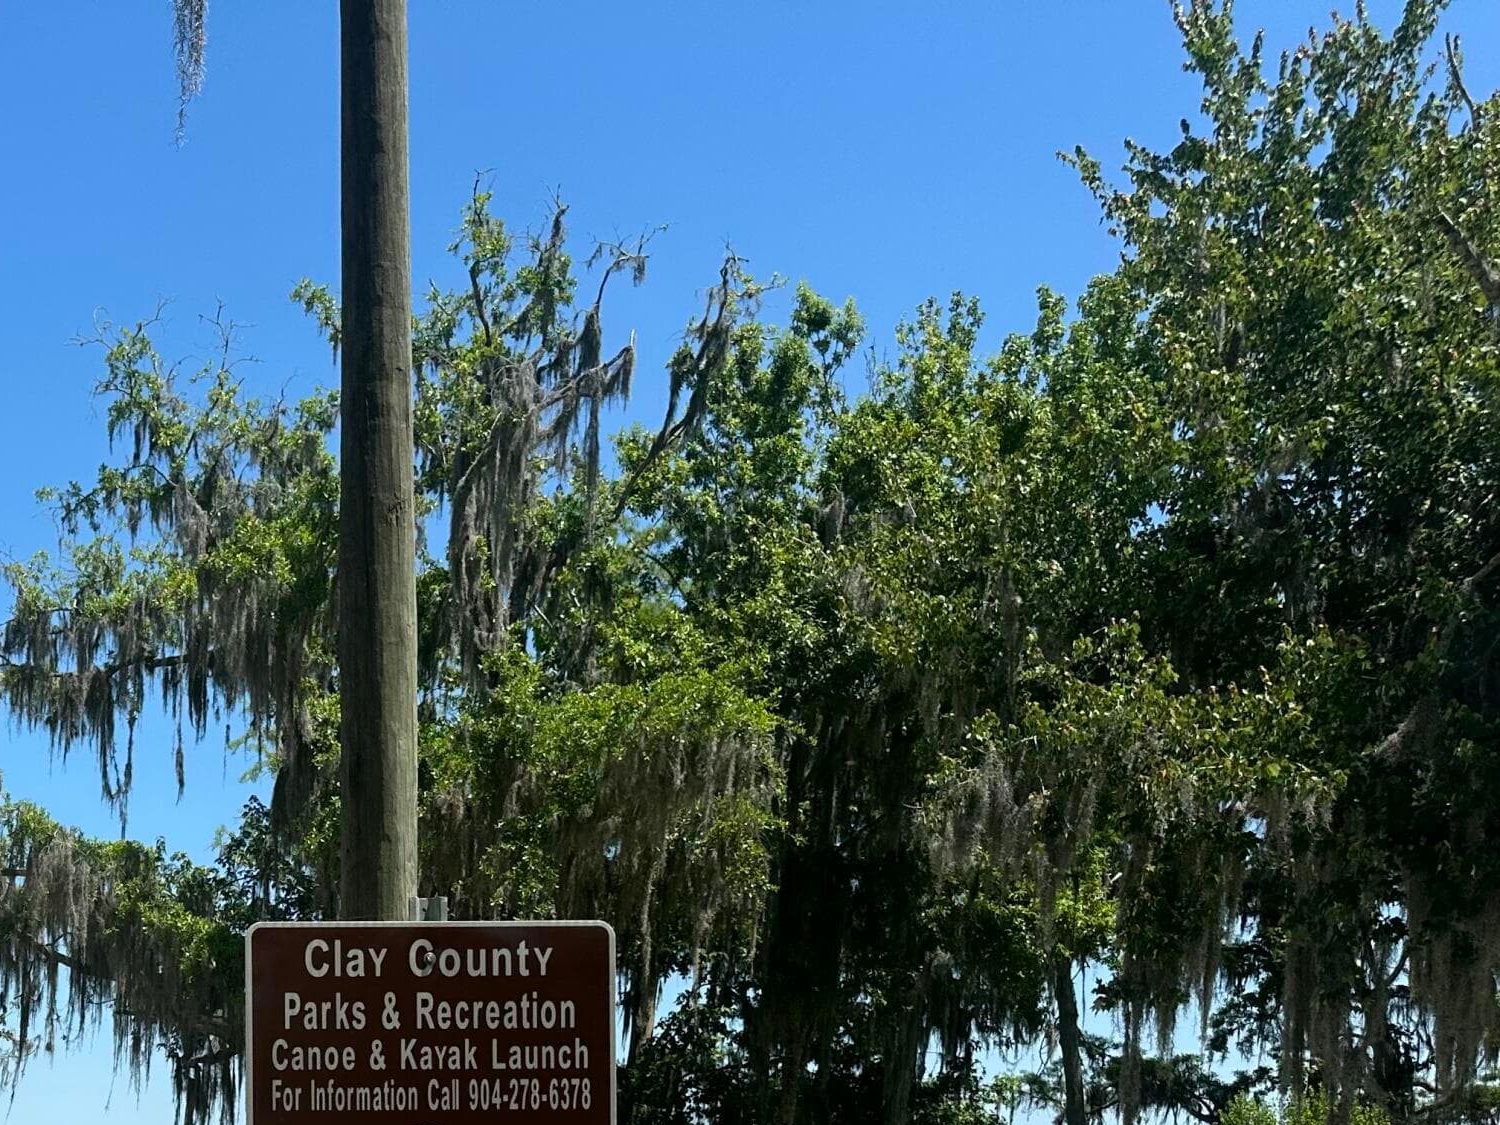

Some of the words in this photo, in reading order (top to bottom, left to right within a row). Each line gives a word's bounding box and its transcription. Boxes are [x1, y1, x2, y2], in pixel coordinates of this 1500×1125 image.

[284, 992, 366, 1030] Parks
[382, 992, 400, 1030] &
[416, 992, 576, 1030] Recreation
[272, 1039, 356, 1071] Canoe
[370, 1039, 386, 1071] &
[400, 1038, 478, 1070] Kayak
[492, 1038, 589, 1070] Launch
[272, 1080, 302, 1111] For
[311, 1079, 418, 1111] Information
[428, 1078, 460, 1111] Call
[469, 1078, 591, 1110] 904-278-6378
